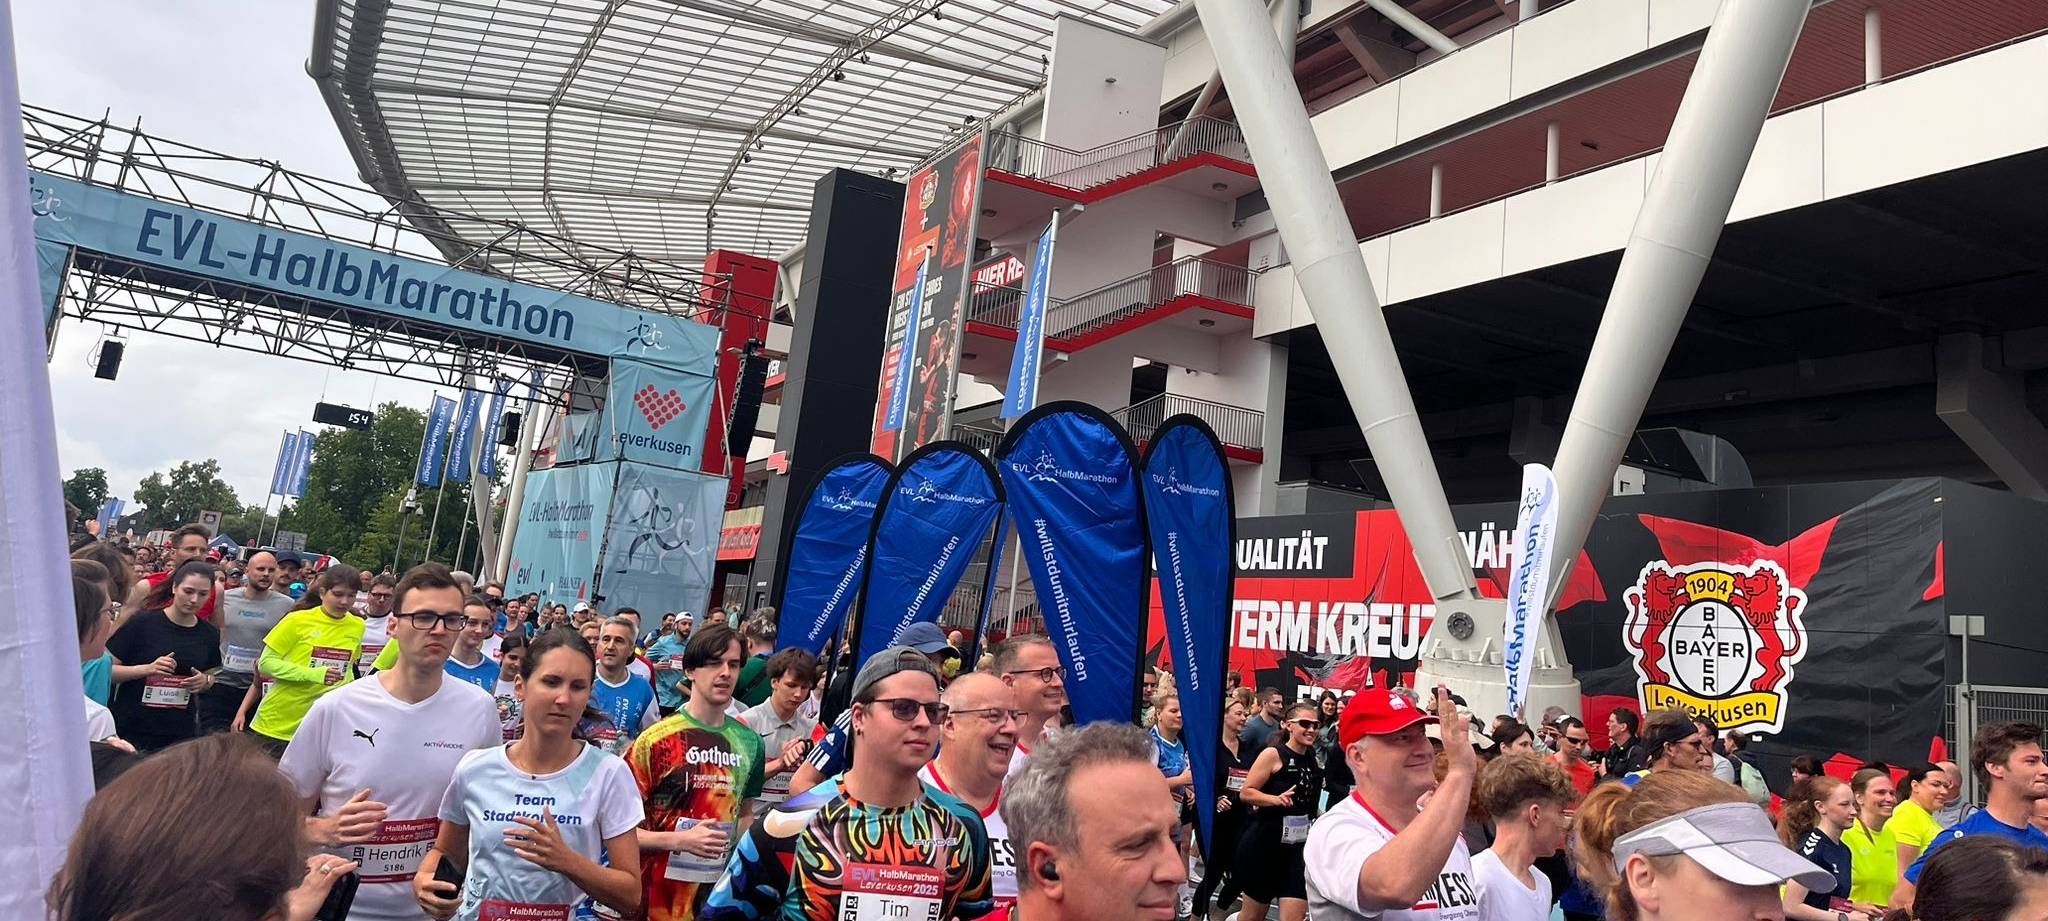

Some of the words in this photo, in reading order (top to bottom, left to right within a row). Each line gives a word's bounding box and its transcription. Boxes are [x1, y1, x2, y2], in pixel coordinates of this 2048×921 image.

[137, 207, 575, 341] EVL-HalbMarathon
[975, 263, 1006, 294] HIER
[1012, 463, 1031, 474] EVL
[1055, 468, 1117, 484] HalbMarathon
[1152, 473, 1165, 486] EVL
[822, 495, 835, 504] EVL
[901, 486, 915, 496] EVL
[934, 490, 985, 505] HalbMarathon
[1236, 530, 1329, 571] UALITÄT
[807, 540, 868, 641] #willstdumitmirlaufe
[886, 535, 960, 649] #willstdumitmirlaufen
[1689, 577, 1728, 595] 1904
[1034, 518, 1088, 682] #willstdumitmirlaufen
[1167, 531, 1199, 692] #willstdumitmirlaufen
[1675, 640, 1745, 658] BAYER
[1702, 606, 1716, 692] BAYER
[685, 744, 743, 768] Gothaer
[514, 794, 556, 807] Team
[369, 844, 422, 861] Hendrik
[383, 864, 405, 872] 5186
[852, 868, 878, 881] EVL
[879, 869, 939, 882] HalbMarathon
[860, 880, 913, 892] Leverkusen
[913, 883, 939, 895] 2025
[1422, 872, 1477, 909] XESS
[509, 906, 564, 917] HalbMarathon
[880, 899, 909, 917] Tim
